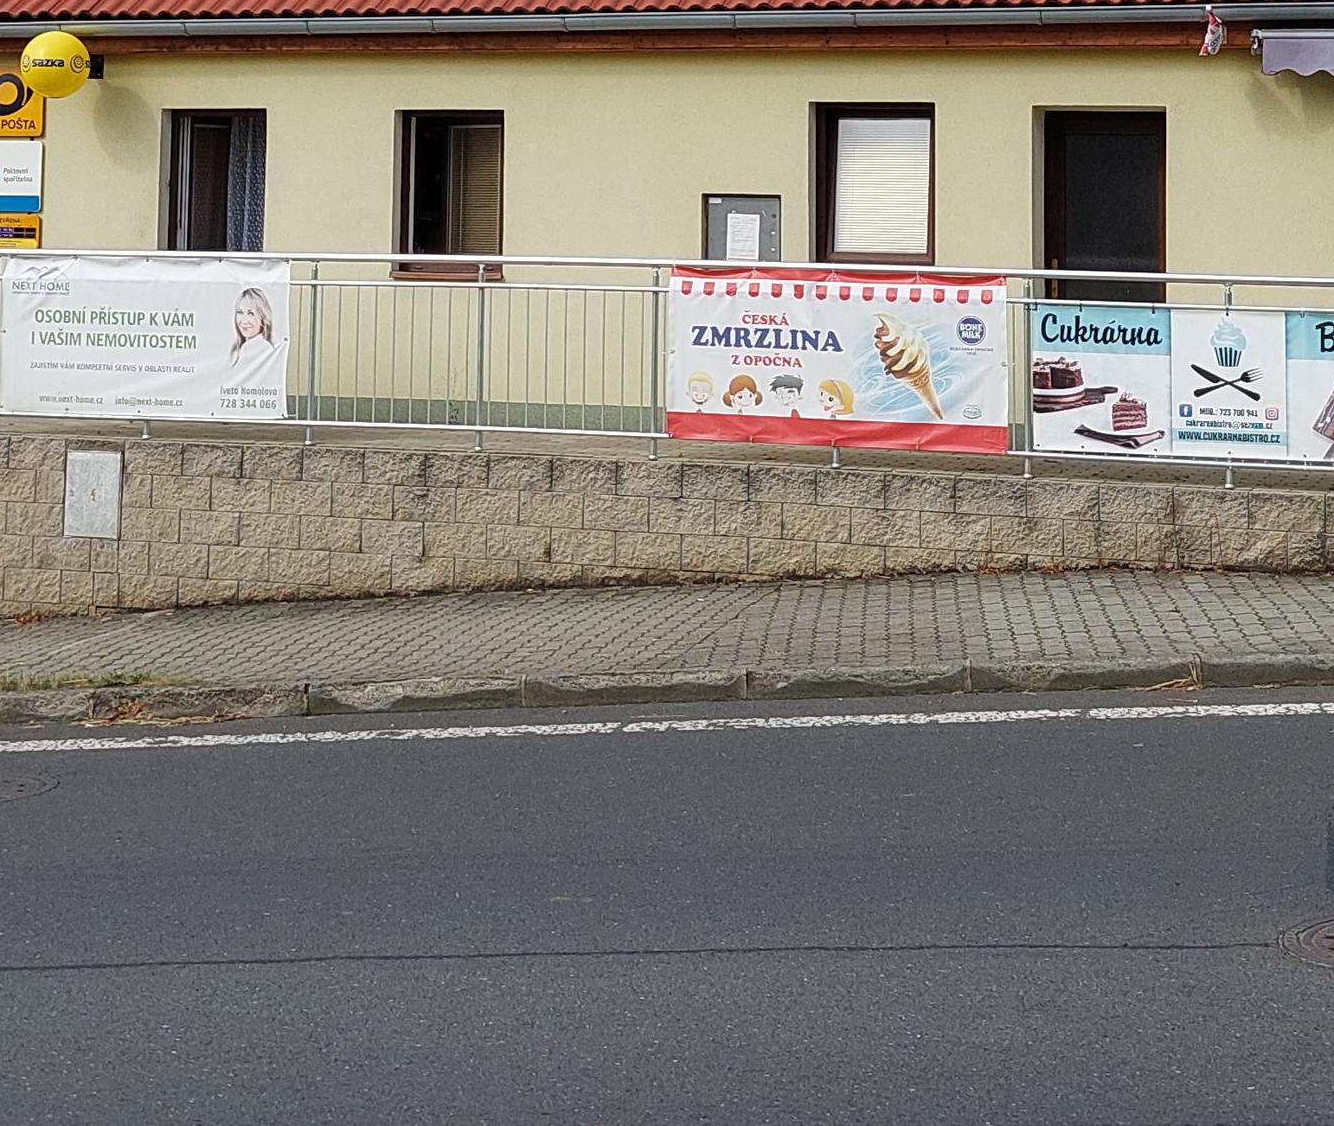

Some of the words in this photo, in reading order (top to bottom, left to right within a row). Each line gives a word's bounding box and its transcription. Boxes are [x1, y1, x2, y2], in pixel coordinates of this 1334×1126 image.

[1, 117, 36, 130] POŠTA
[12, 281, 37, 291] NEXT
[39, 281, 70, 291] HOME
[34, 306, 86, 324] OSOBNÍ
[90, 306, 145, 327] PŘÍSTUP
[149, 312, 160, 327] K
[161, 308, 195, 328] VÁM
[741, 310, 788, 326] ČESKÁ
[1041, 312, 1164, 346] Cukrárna
[30, 331, 36, 346] I
[38, 328, 82, 347] VAŠIM
[86, 332, 197, 350] NEMOVITOSTEM
[691, 325, 844, 353] ZMRZLINA
[731, 354, 742, 366] Z
[744, 352, 803, 369] OPOČNA
[220, 398, 237, 408] 728
[239, 399, 257, 409] 344
[259, 399, 277, 410] 066
[1219, 408, 1232, 417] 723
[1233, 408, 1245, 418] 700
